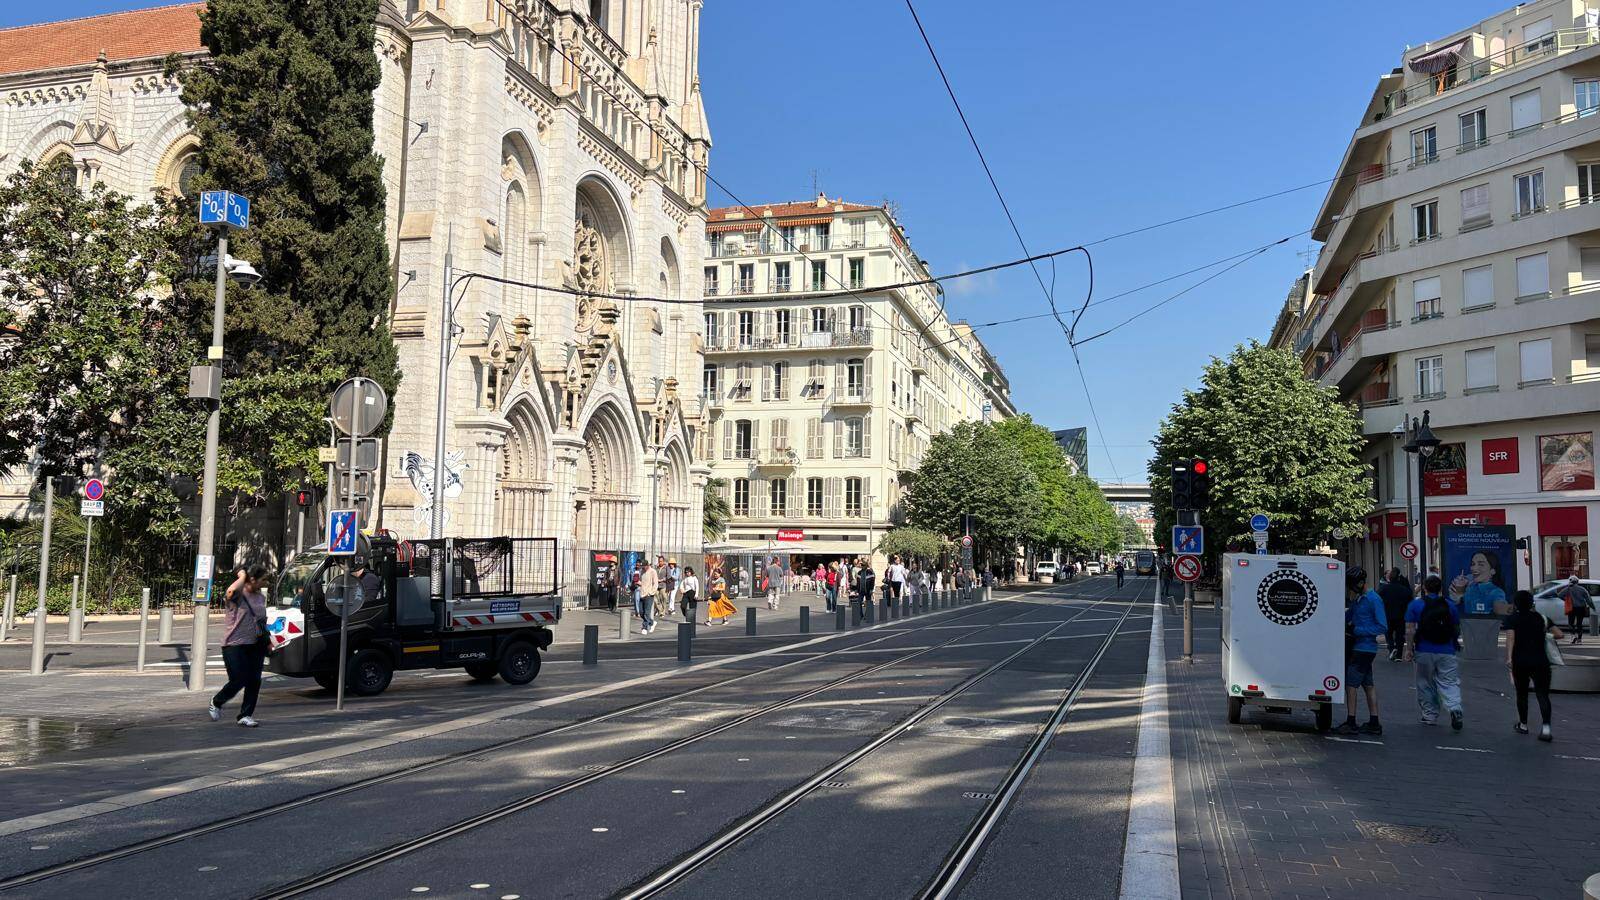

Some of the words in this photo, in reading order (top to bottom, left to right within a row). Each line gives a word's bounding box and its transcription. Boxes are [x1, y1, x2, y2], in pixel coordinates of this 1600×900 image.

[204, 193, 224, 221] SOS
[228, 194, 246, 227] SOS
[1489, 452, 1508, 461] SFR
[778, 532, 803, 540] Malongo
[1327, 679, 1336, 687] 15
